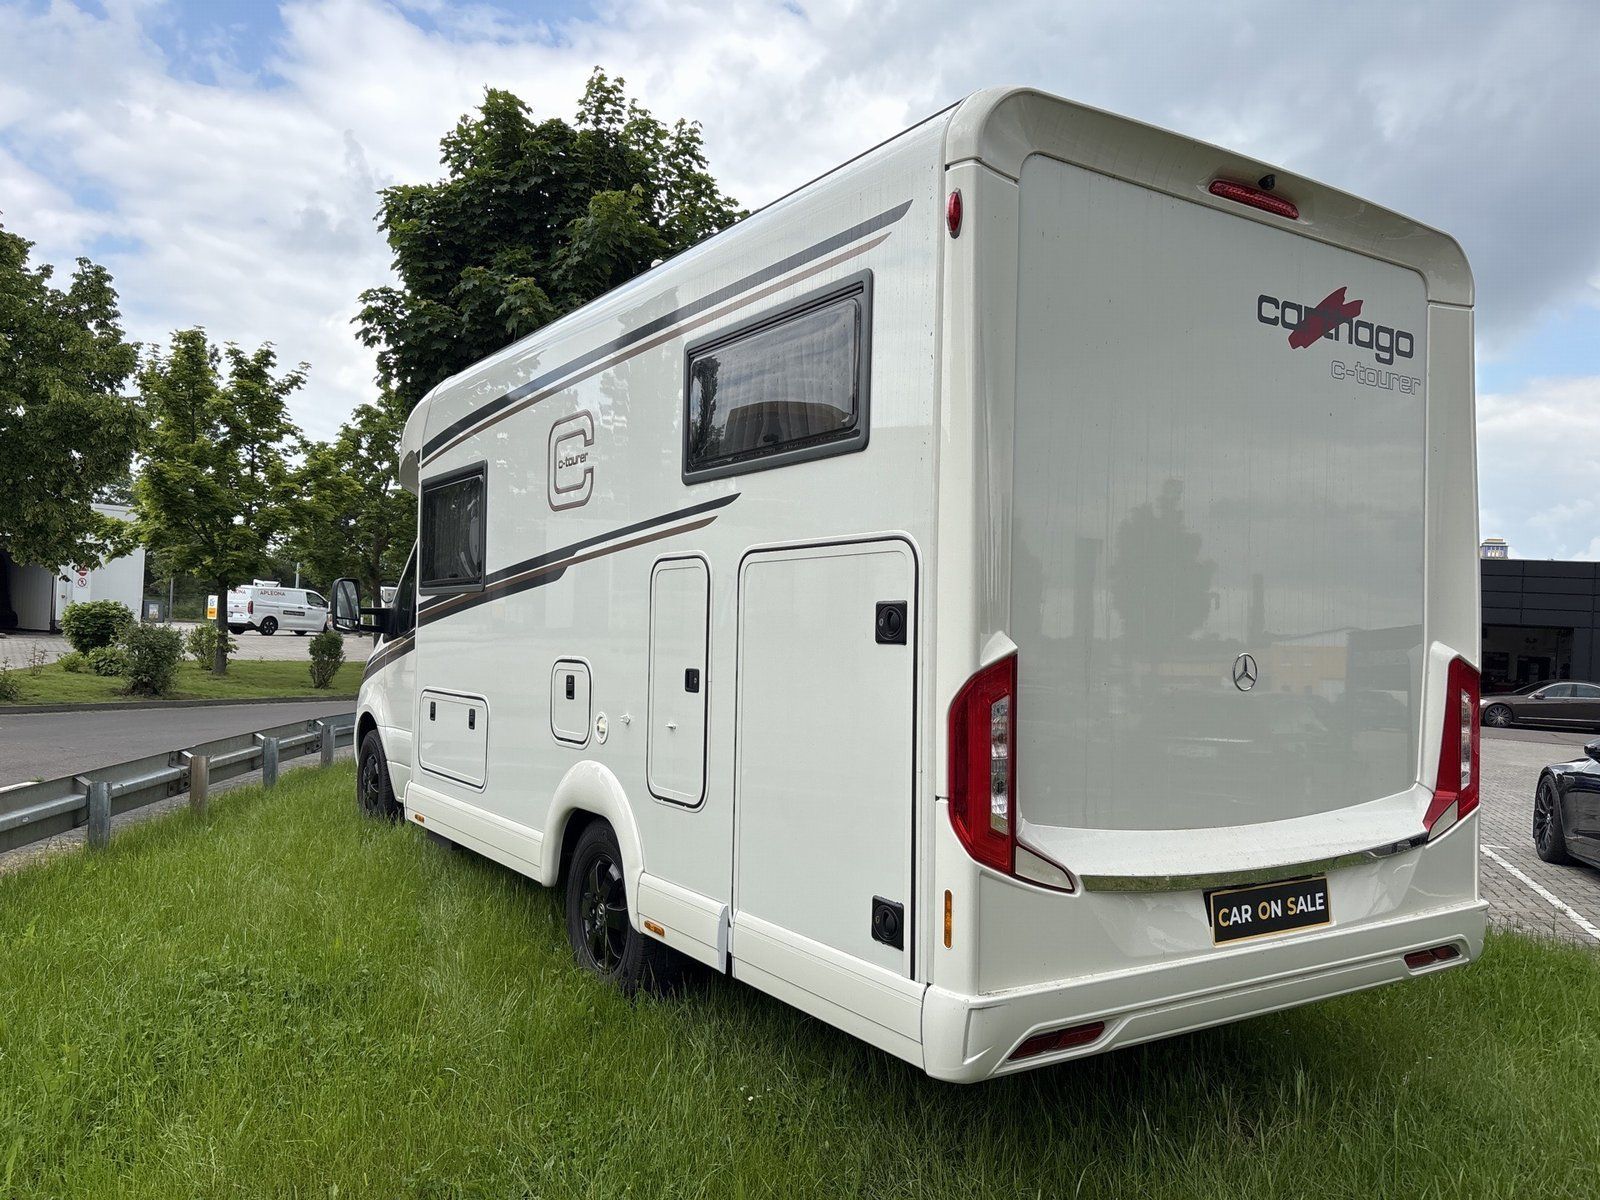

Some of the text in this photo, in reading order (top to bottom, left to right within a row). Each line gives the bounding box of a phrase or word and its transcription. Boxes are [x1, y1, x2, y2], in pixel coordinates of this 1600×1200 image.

[1331, 360, 1421, 395] c-tourer
[558, 452, 588, 469] c-tourer
[1218, 892, 1325, 927] CAR ON SALE
